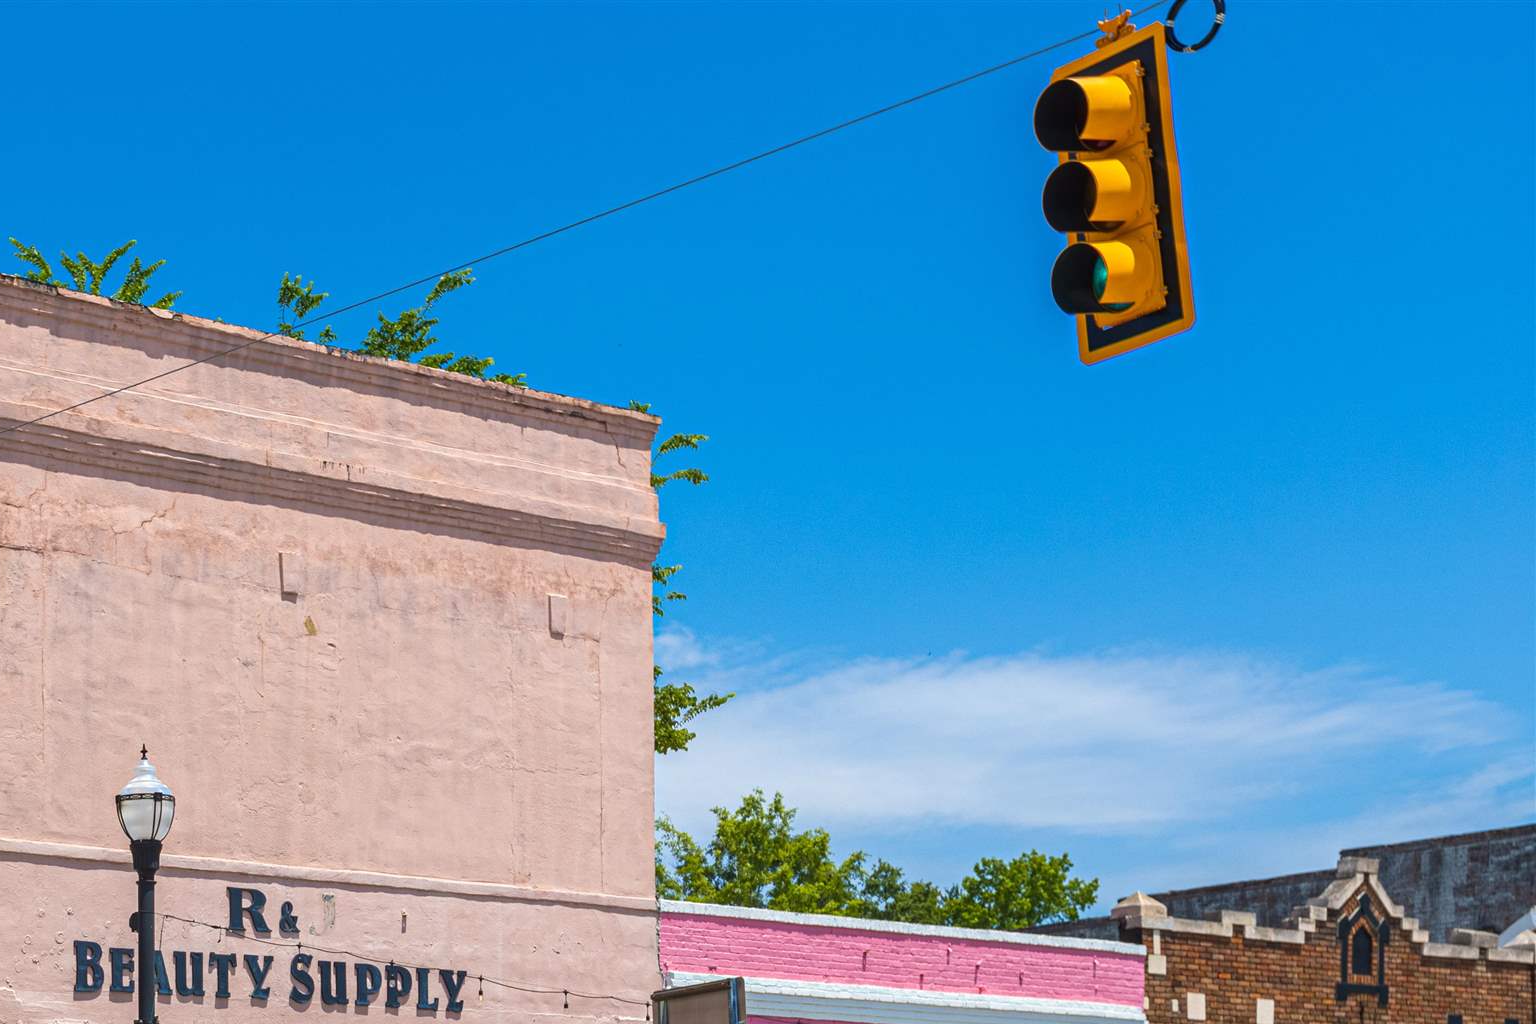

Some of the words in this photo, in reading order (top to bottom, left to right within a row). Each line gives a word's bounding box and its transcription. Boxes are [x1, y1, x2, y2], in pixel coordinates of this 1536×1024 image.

[226, 886, 272, 933] R
[279, 901, 300, 934] &
[73, 940, 274, 999] BEAUTY
[289, 953, 468, 1013] SUPPLY
